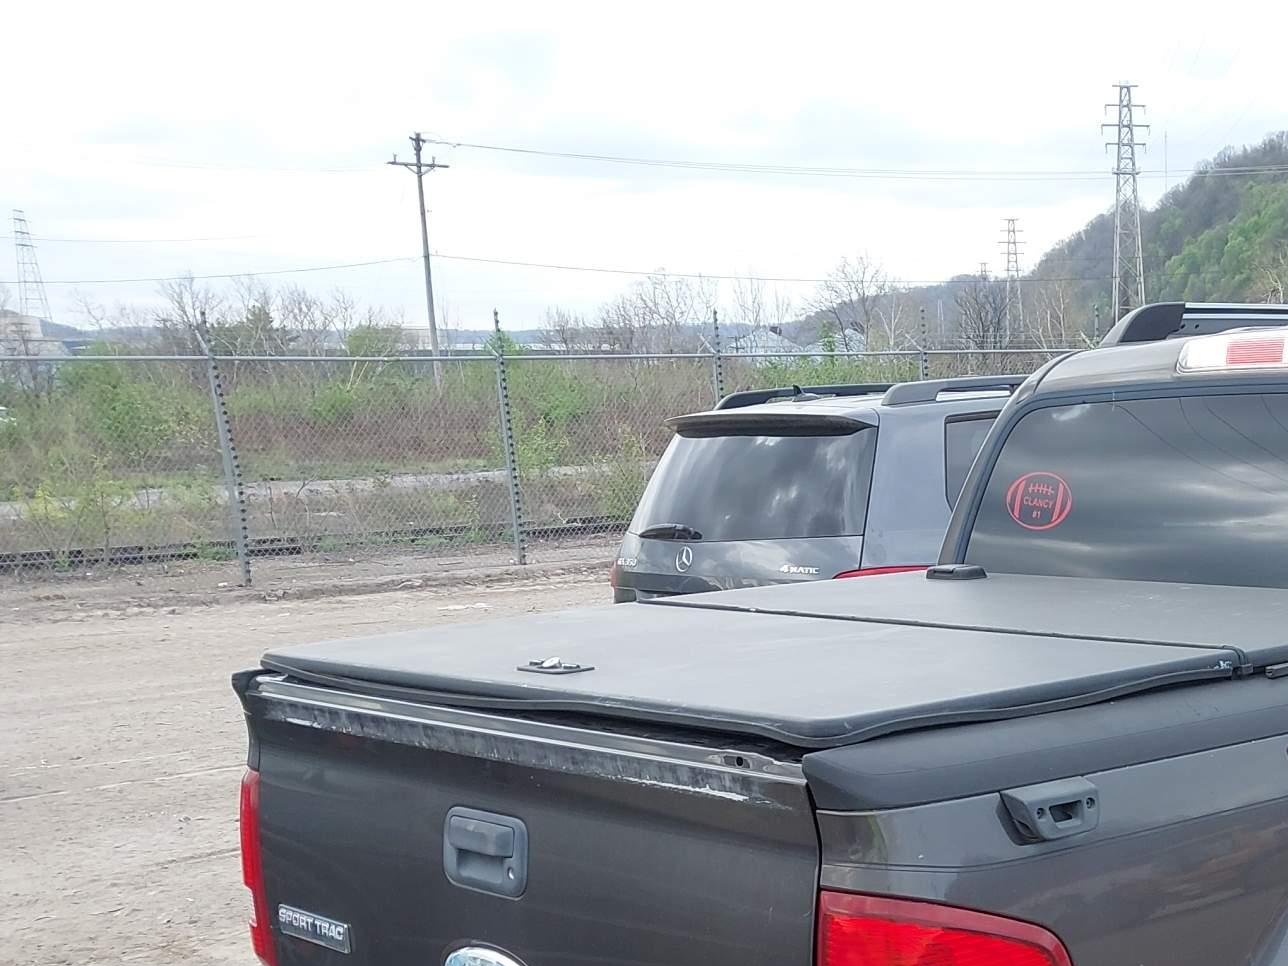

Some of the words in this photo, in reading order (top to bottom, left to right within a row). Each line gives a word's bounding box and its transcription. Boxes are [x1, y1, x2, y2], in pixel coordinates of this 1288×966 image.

[1023, 497, 1053, 508] CLANCY
[1032, 511, 1041, 519] #1
[780, 564, 820, 574] 4MATIC
[278, 908, 313, 931] SPORT
[314, 919, 344, 940] TRAC
